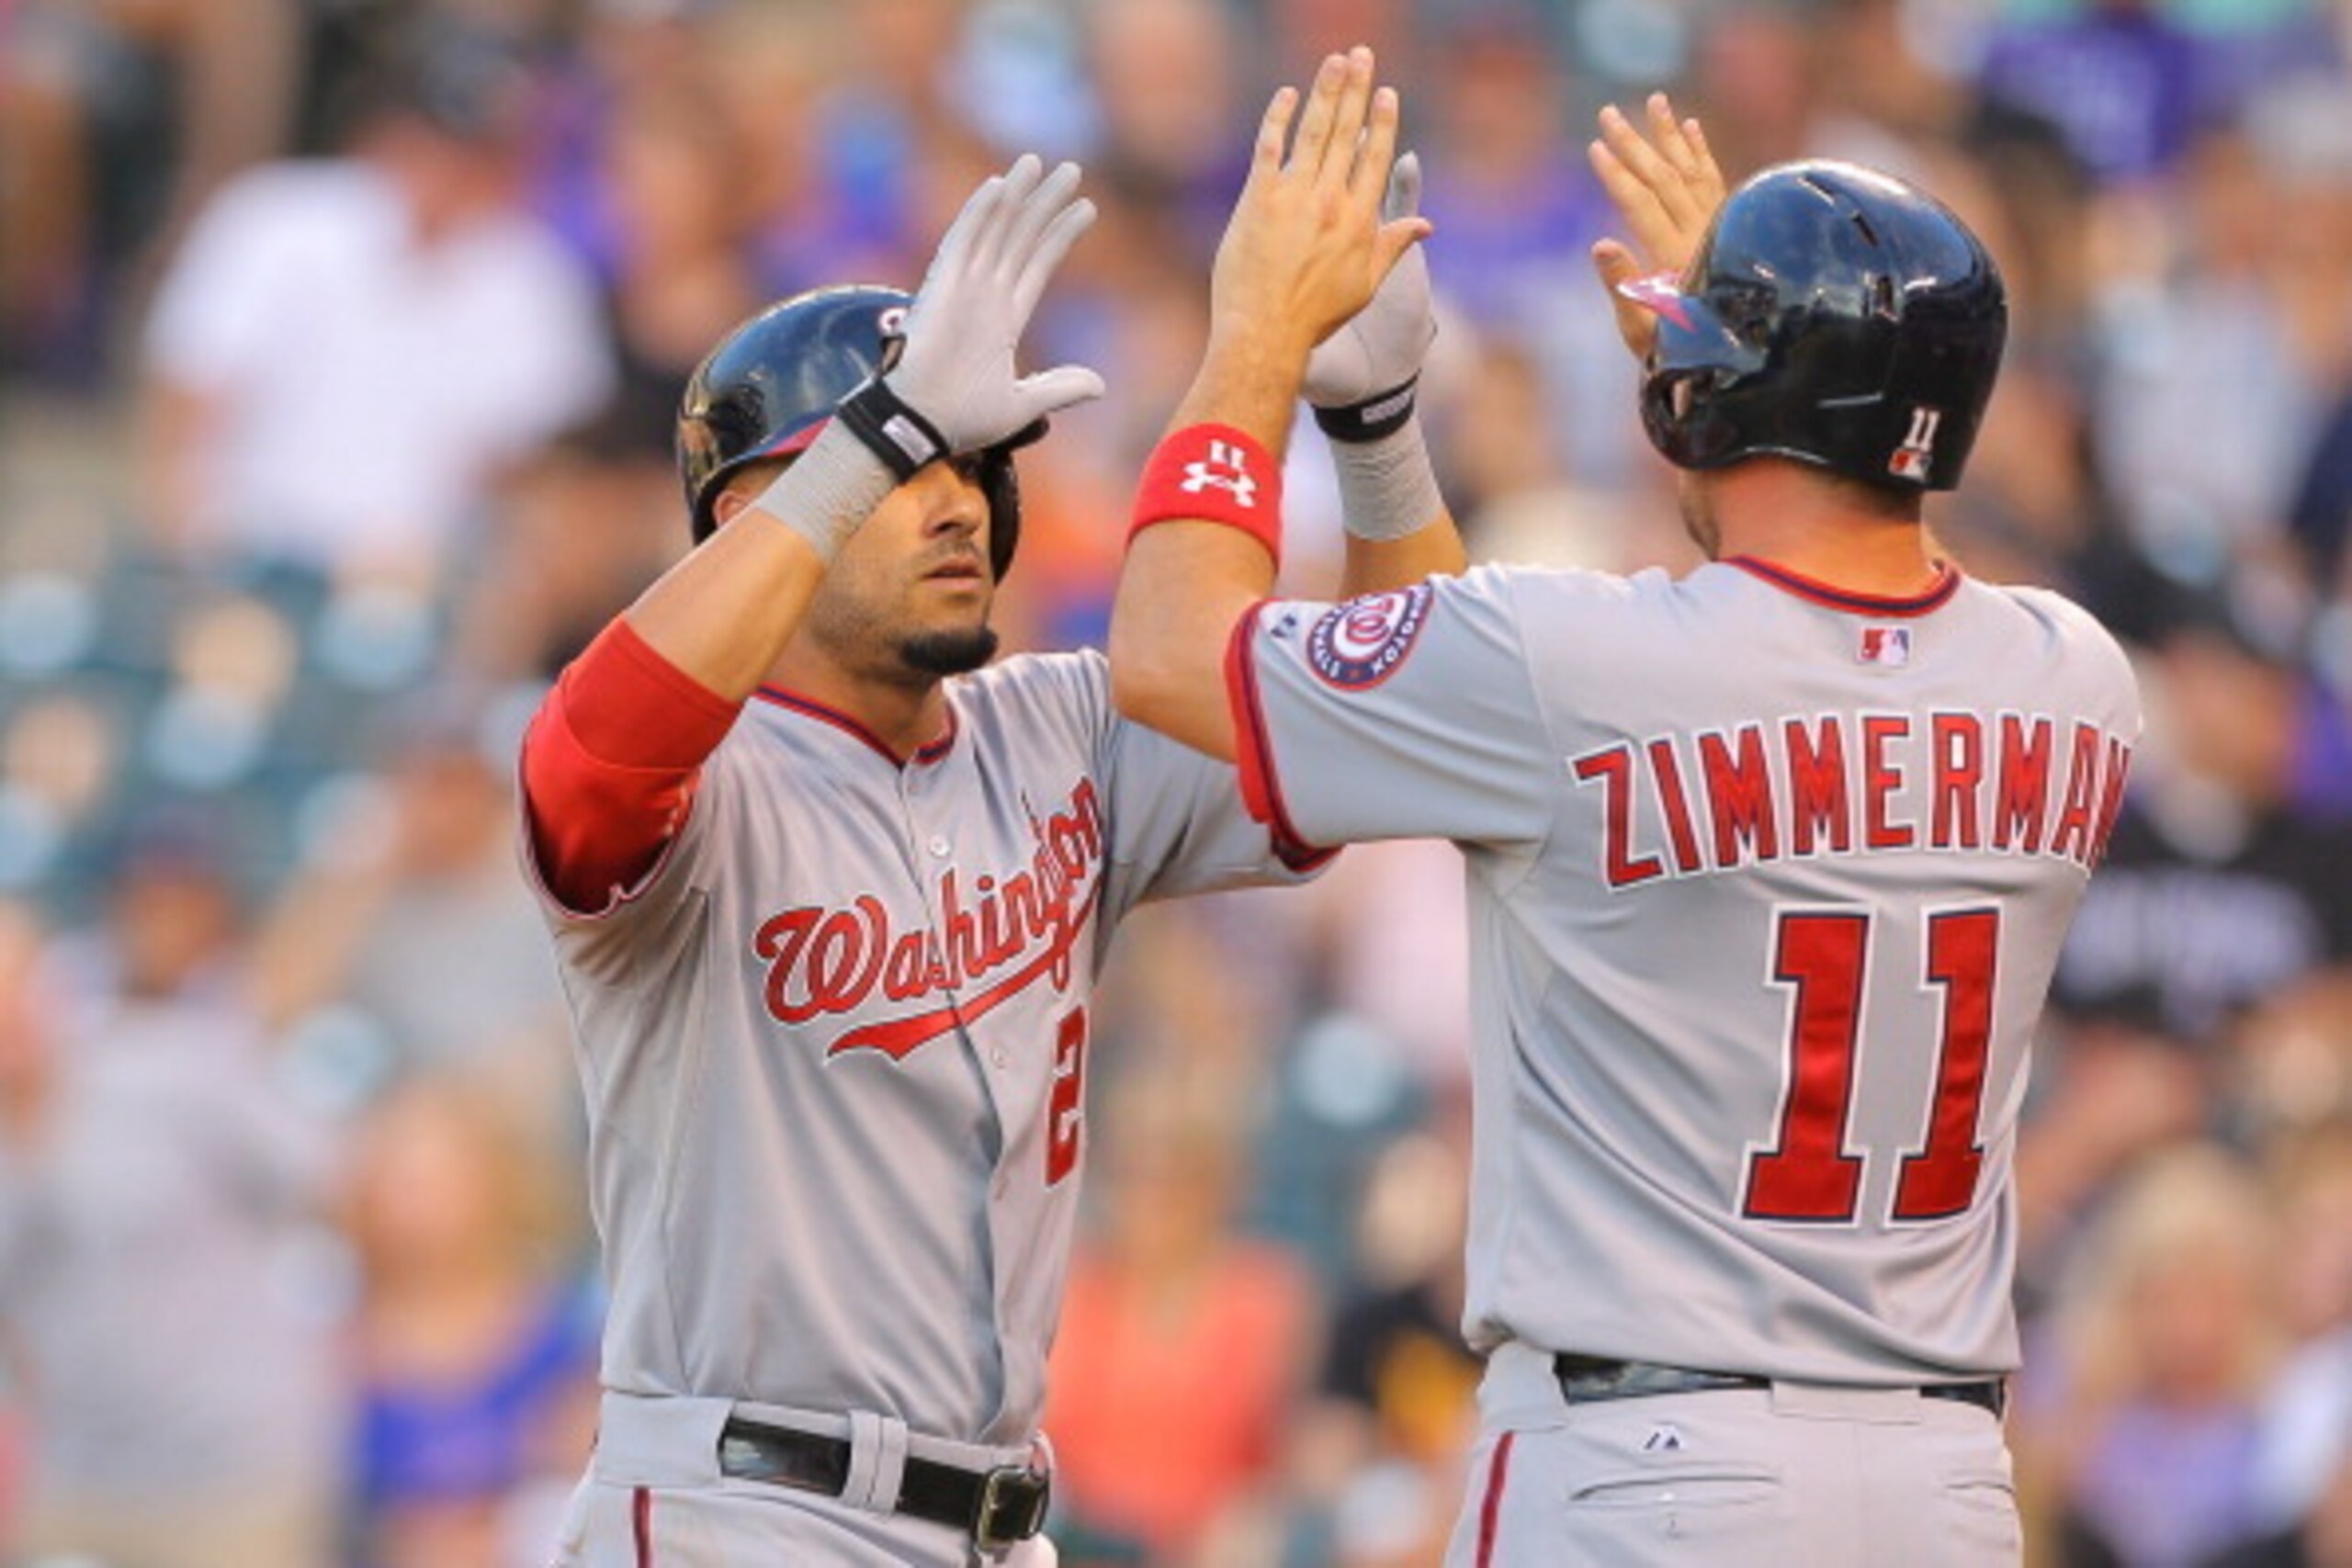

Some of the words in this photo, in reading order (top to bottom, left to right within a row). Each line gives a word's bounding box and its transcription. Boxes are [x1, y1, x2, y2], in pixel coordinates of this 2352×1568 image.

[1210, 439, 1246, 471] 11
[1904, 407, 1940, 452] 11
[1567, 709, 2132, 893] ZIMMERMAN
[1735, 899, 2004, 1229] 11
